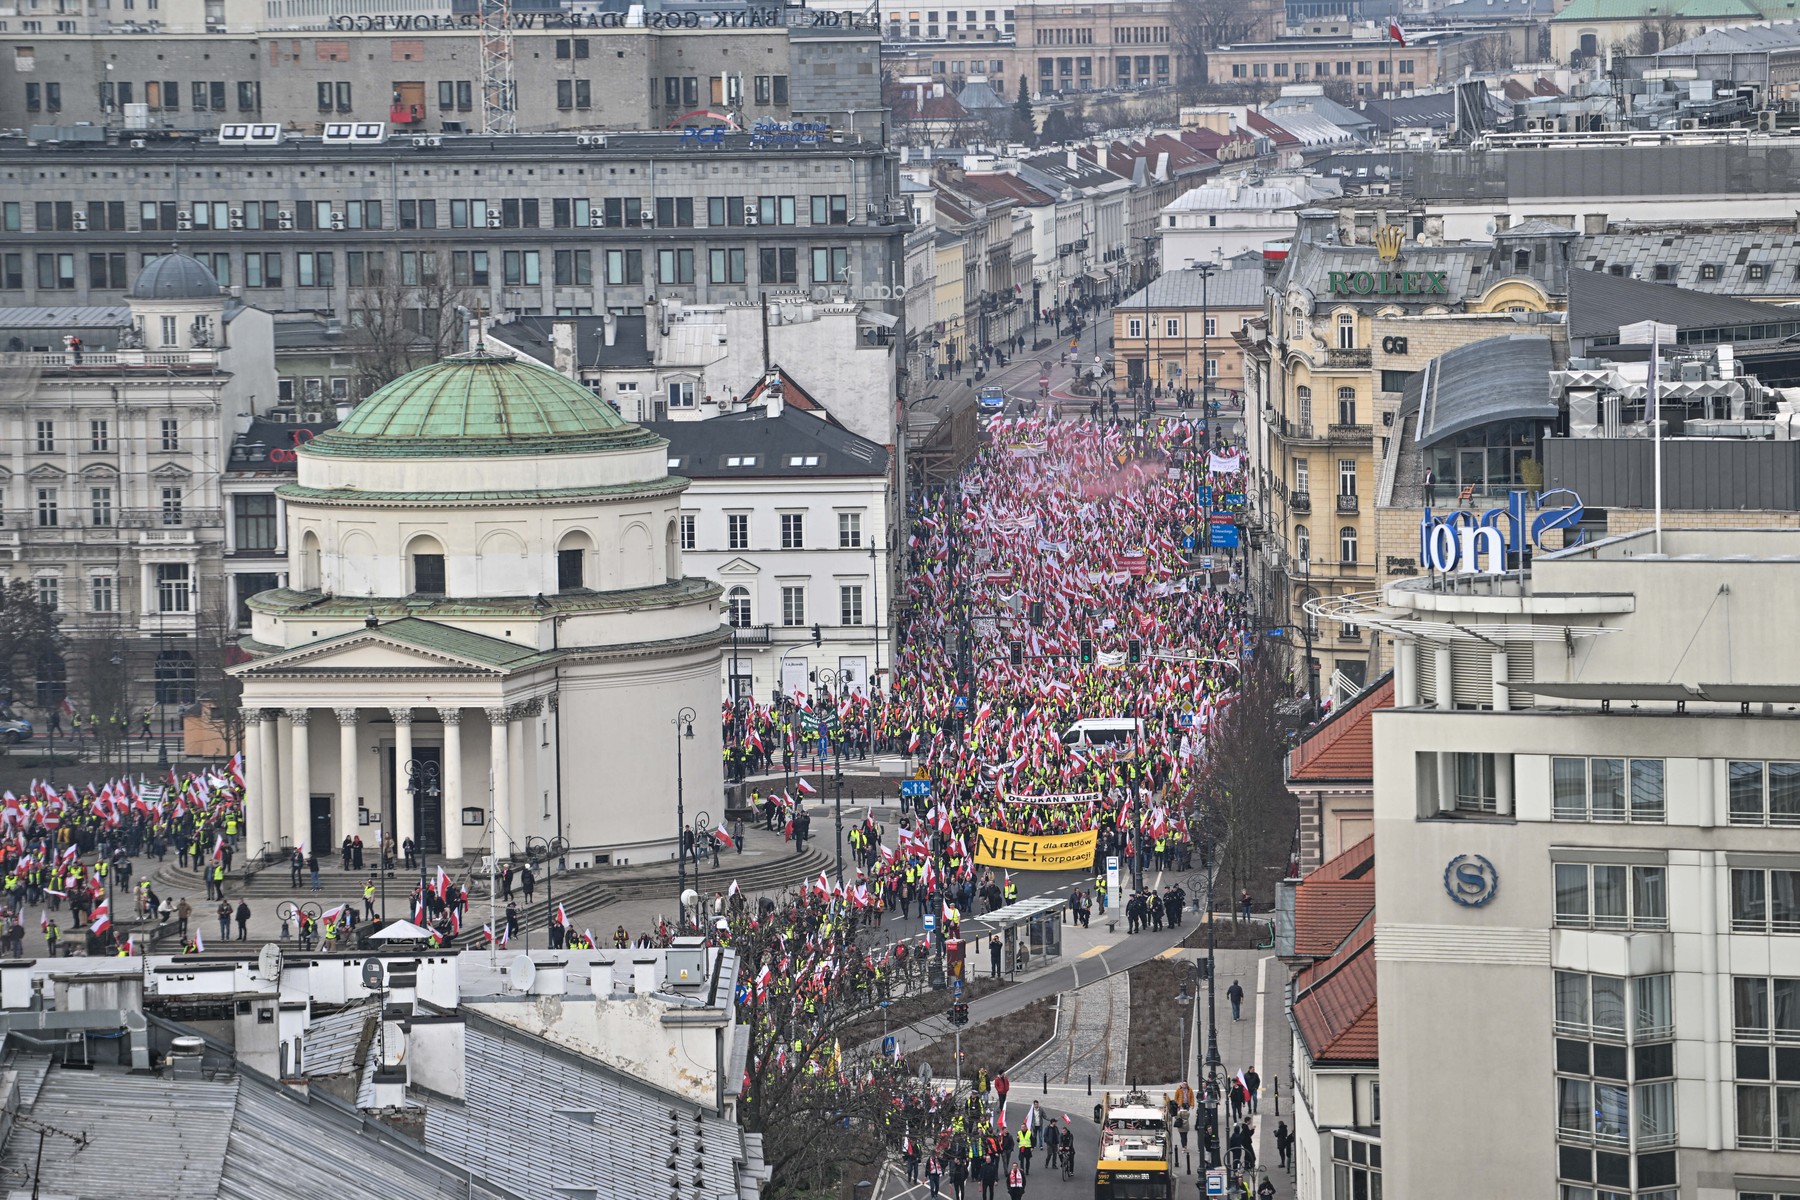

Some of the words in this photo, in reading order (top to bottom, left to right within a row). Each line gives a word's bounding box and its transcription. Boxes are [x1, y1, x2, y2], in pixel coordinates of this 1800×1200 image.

[680, 127, 725, 143] PGE
[1328, 271, 1447, 295] ROLEX
[1382, 335, 1408, 354] CGI
[1386, 555, 1415, 567] Hogan
[1386, 565, 1418, 575] Lovells
[1008, 794, 1067, 803] OSZUKANA
[975, 833, 1038, 862] NIE!
[1060, 838, 1092, 850] rządów
[1041, 852, 1091, 864] korporacji
[1456, 863, 1485, 894] S
